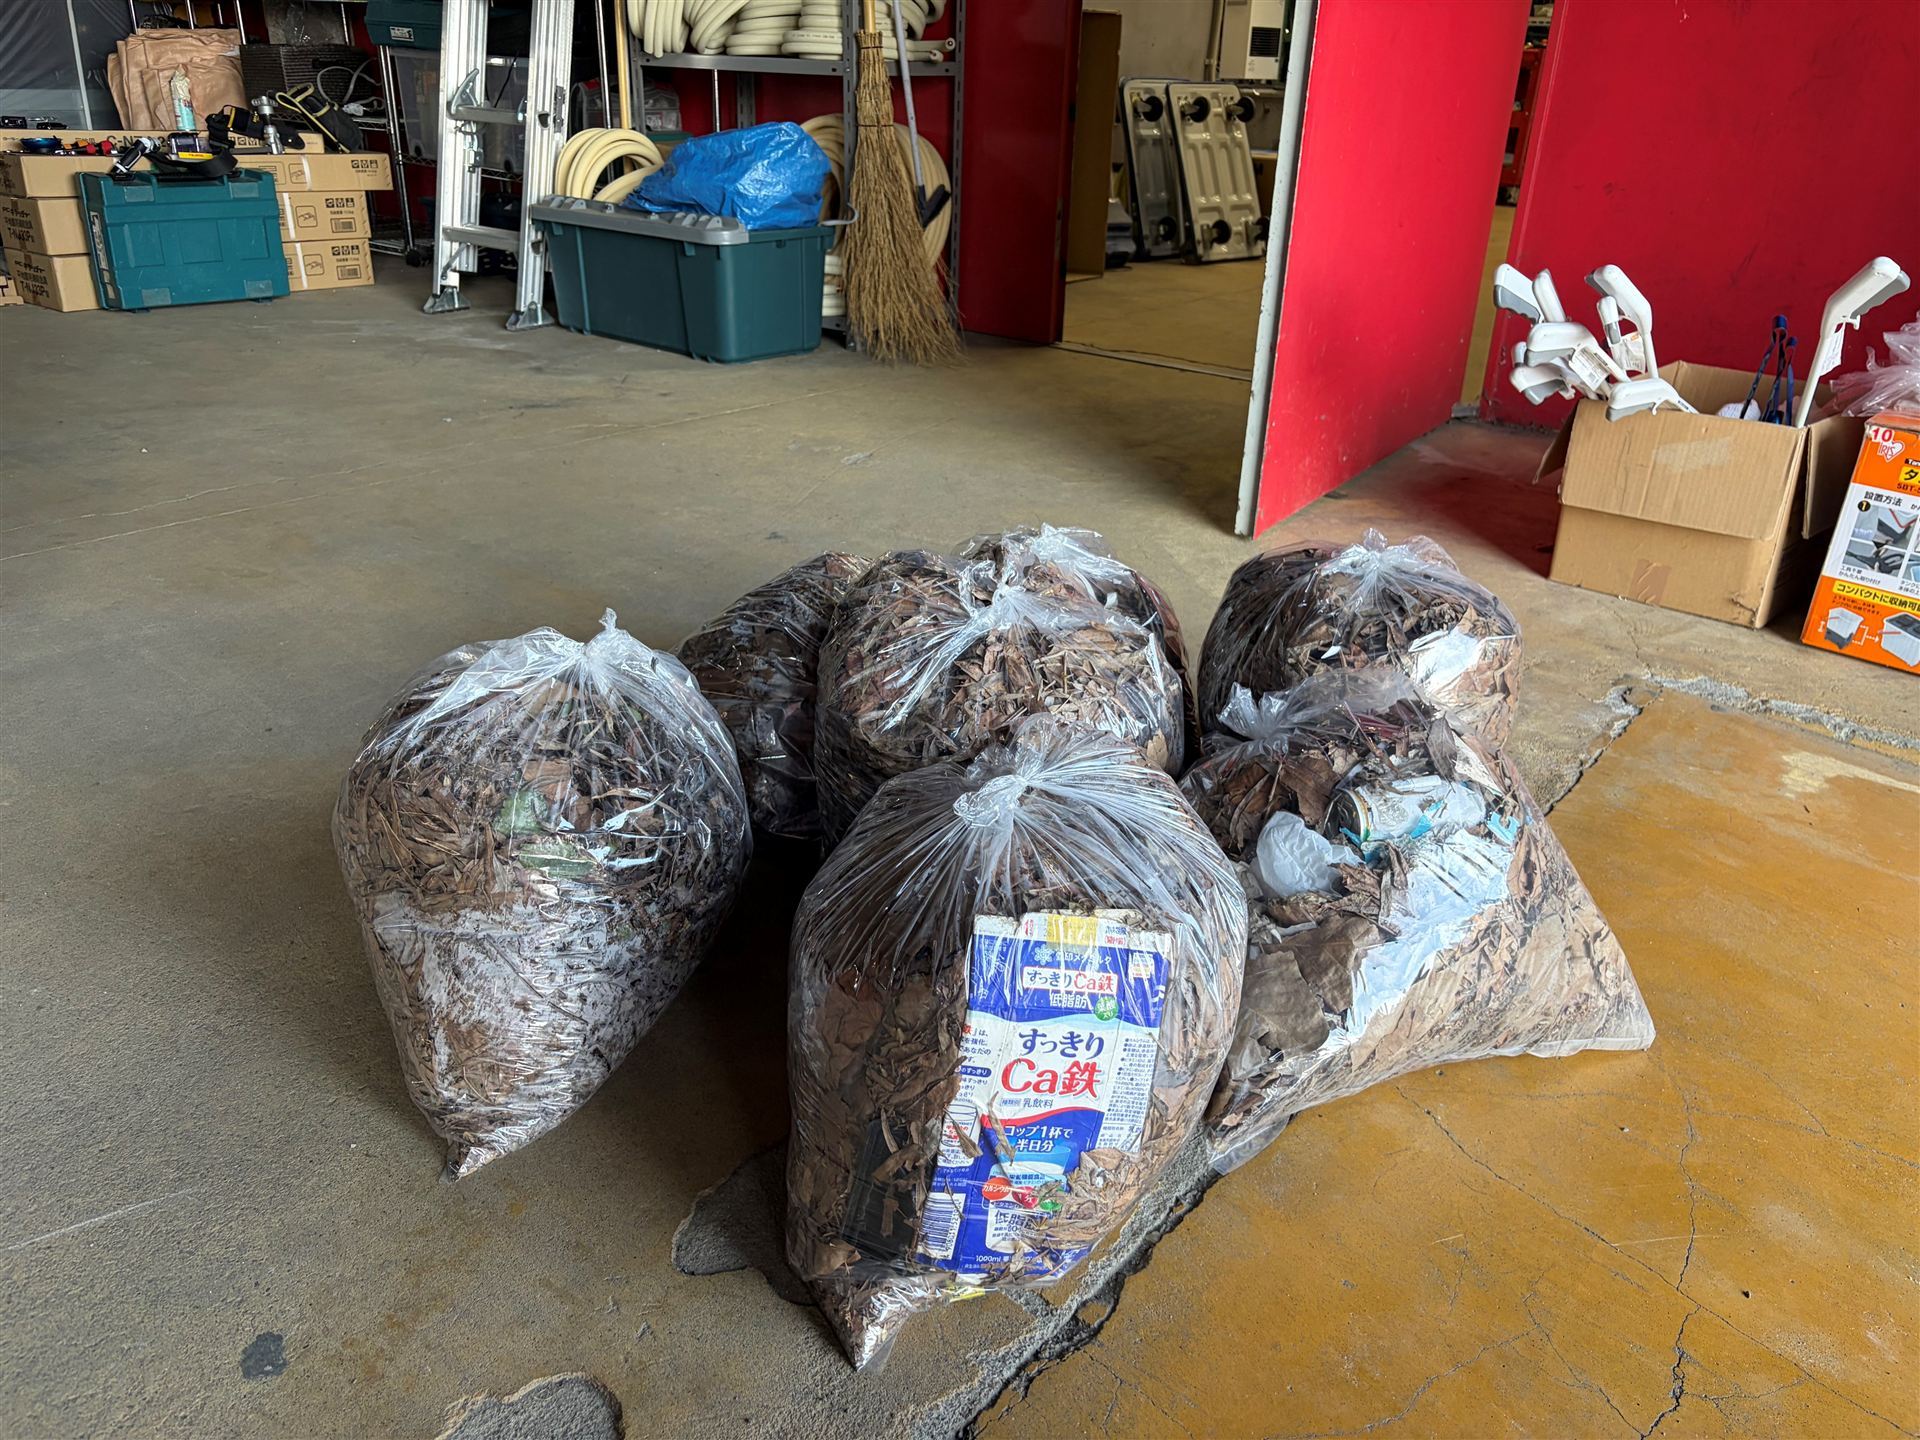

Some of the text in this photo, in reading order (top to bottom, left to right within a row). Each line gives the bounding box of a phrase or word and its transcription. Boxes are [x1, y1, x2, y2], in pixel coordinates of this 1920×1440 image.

[1872, 427, 1893, 442] 10
[1879, 442, 1896, 457] IRIS
[1904, 469, 1920, 484] タ
[1864, 491, 1903, 507] 設置方法
[1026, 970, 1114, 993] すっきりCa鉄
[1049, 993, 1087, 1009] 低脂肪
[1018, 1028, 1105, 1060] すっきり
[1001, 1058, 1102, 1098] Ca鉄
[1023, 1097, 1054, 1108] 乳飲料
[1004, 1125, 1073, 1139] コップ1杯で
[1015, 1138, 1054, 1152] 半日分
